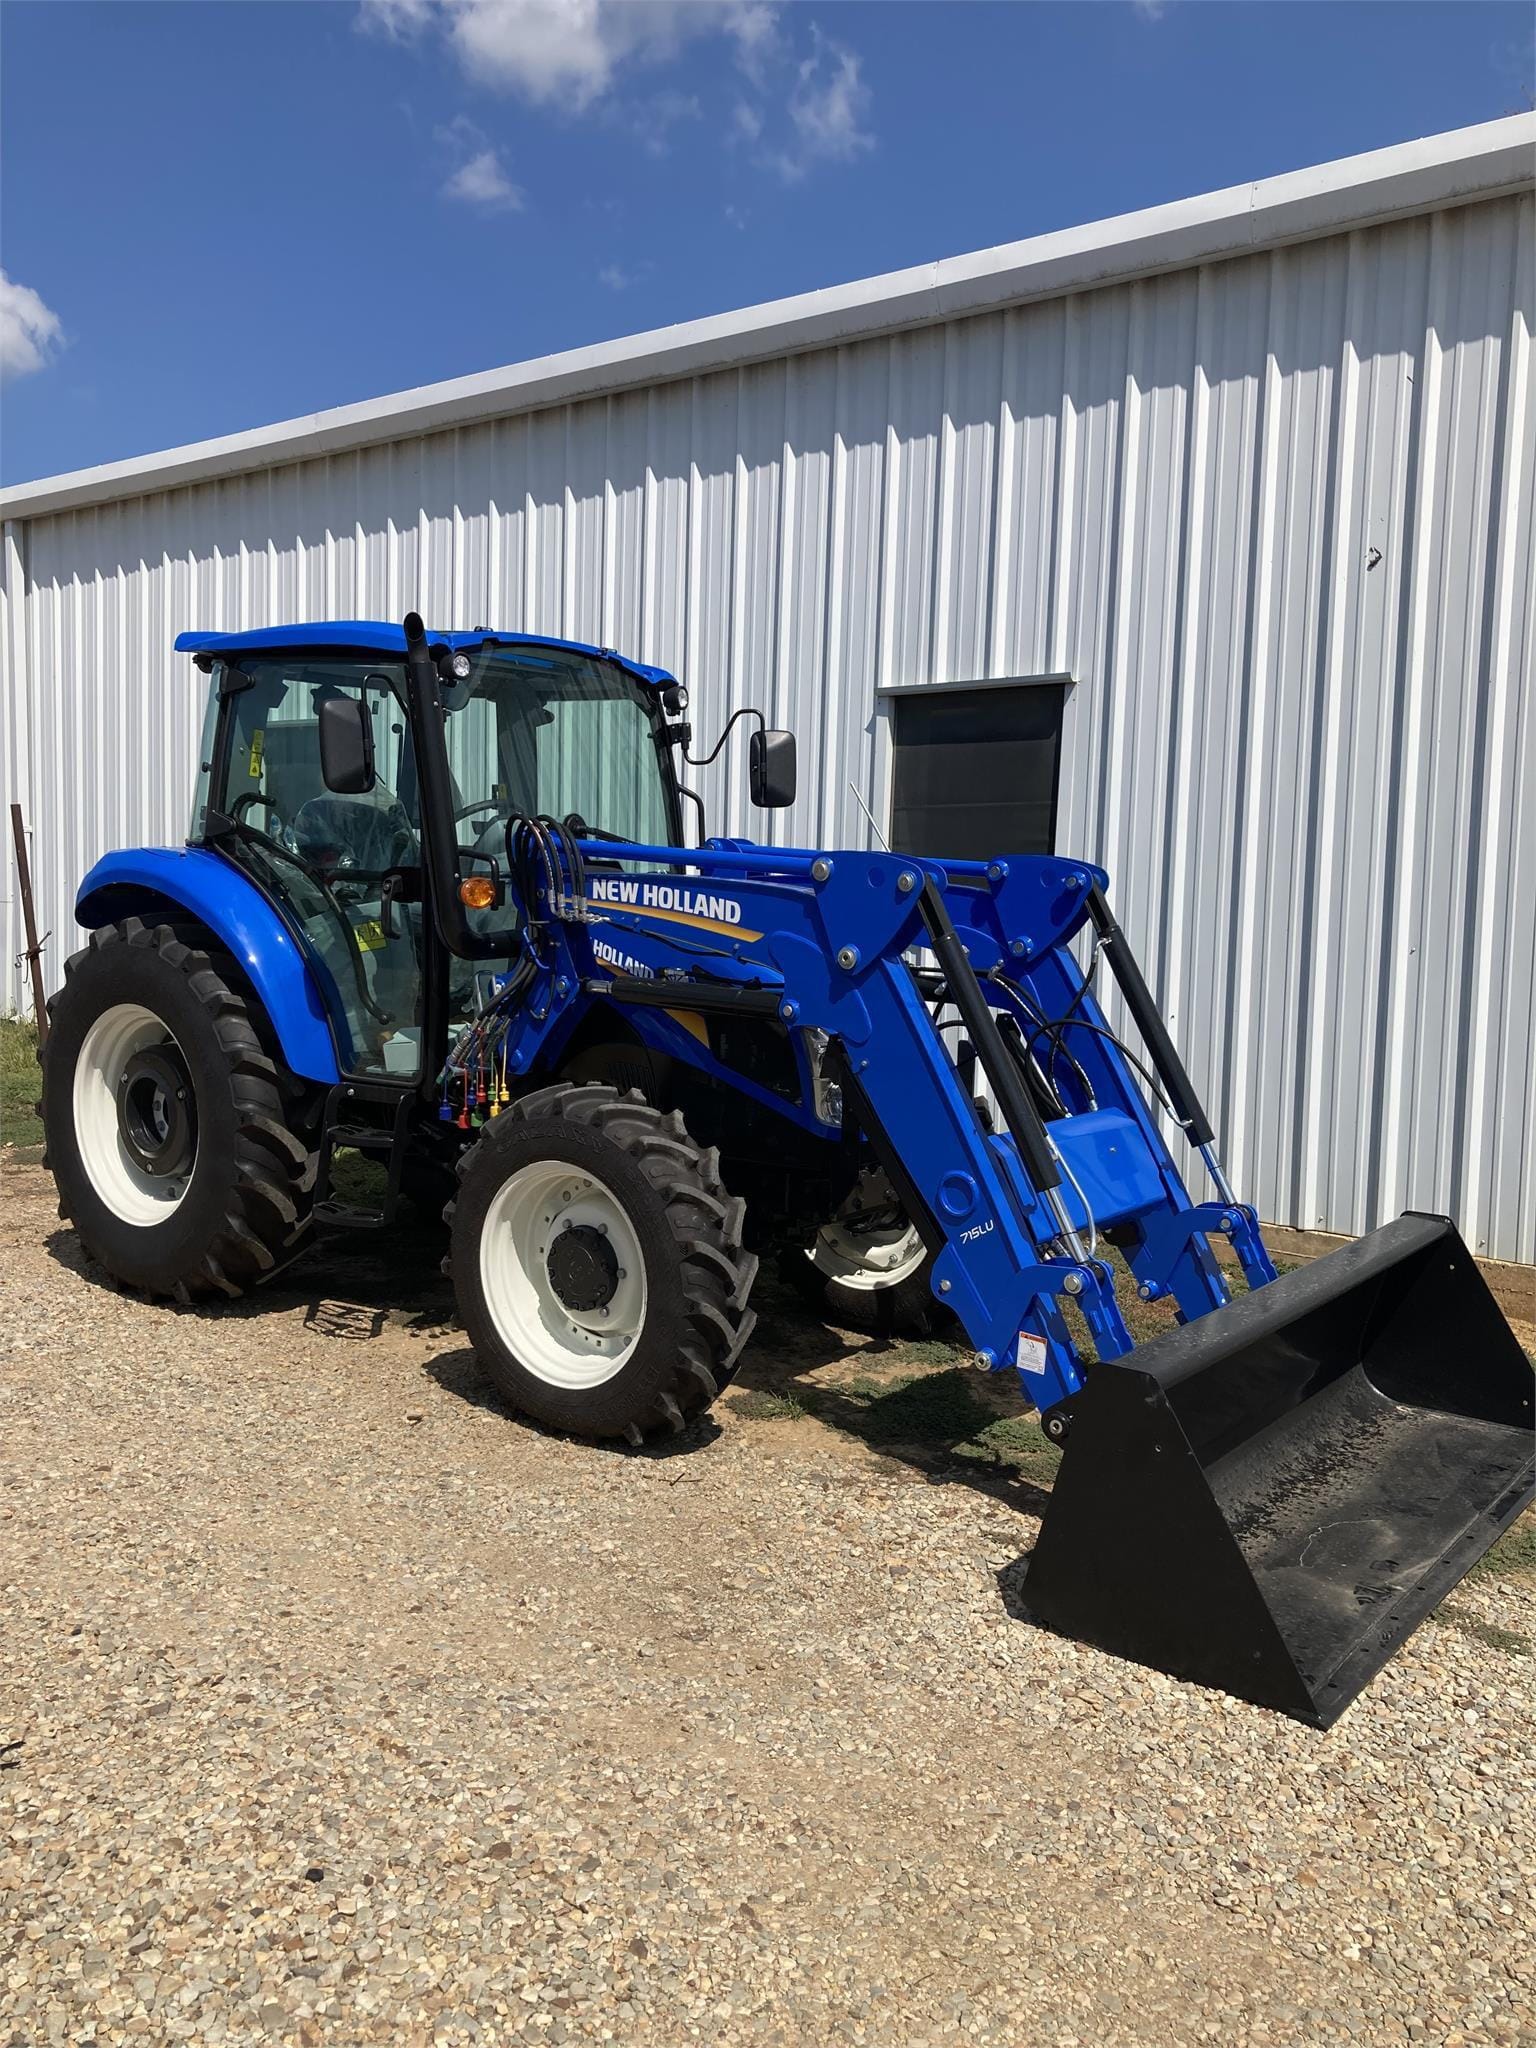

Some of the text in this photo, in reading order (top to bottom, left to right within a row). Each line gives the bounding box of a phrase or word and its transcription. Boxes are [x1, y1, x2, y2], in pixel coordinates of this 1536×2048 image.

[592, 879, 741, 924] NEW HOLLAND
[593, 939, 655, 979] HOLLAND
[959, 1219, 994, 1244] 715LU
